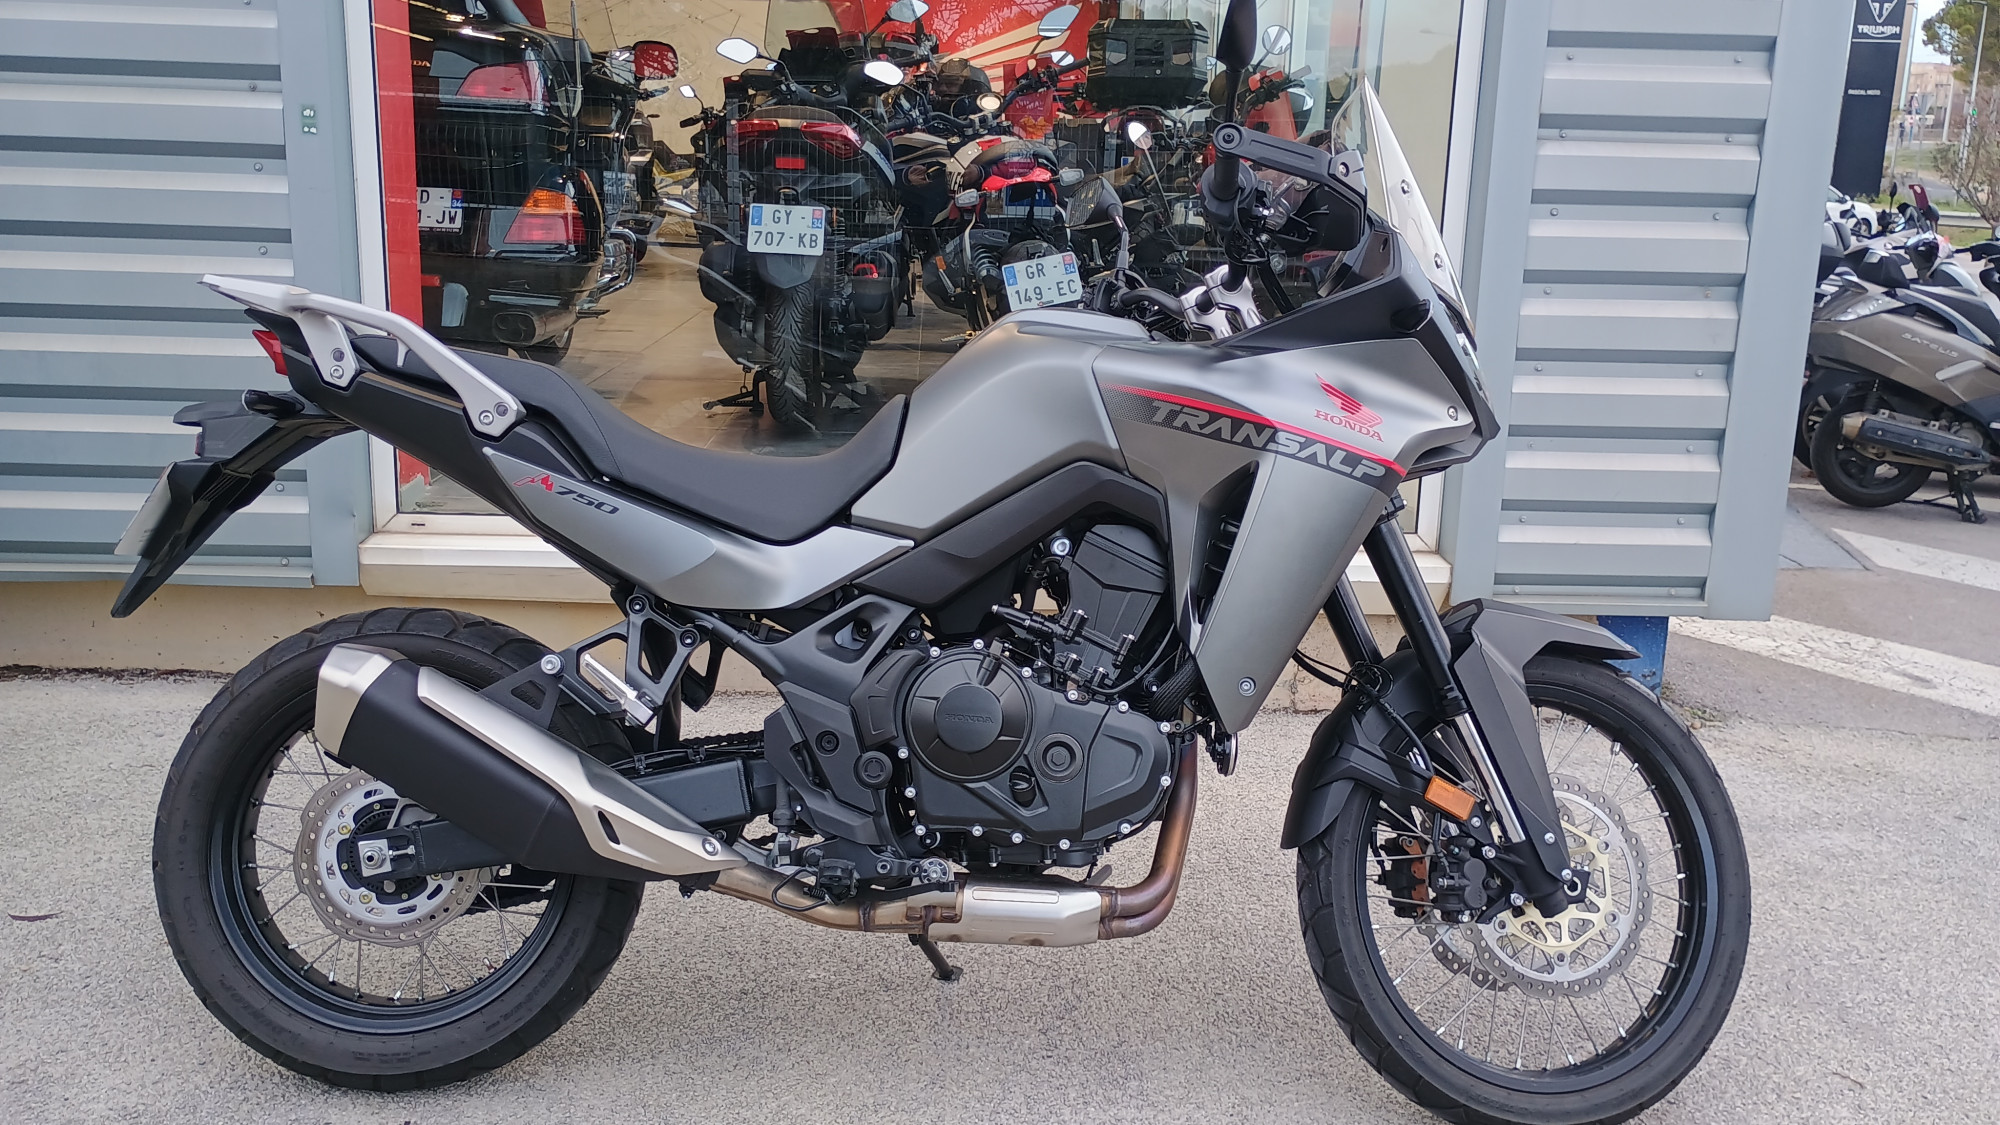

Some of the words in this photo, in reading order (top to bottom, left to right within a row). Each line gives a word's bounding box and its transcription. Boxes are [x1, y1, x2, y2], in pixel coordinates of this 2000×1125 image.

[1857, 24, 1900, 36] TRIUMPH
[417, 189, 430, 204] D
[451, 199, 462, 208] 34
[812, 218, 822, 229] 34
[1064, 264, 1076, 274] 34
[1314, 408, 1384, 443] HONDA
[1150, 400, 1386, 479] TRANSALP
[555, 485, 620, 515] 750
[945, 713, 994, 724] HONDA
